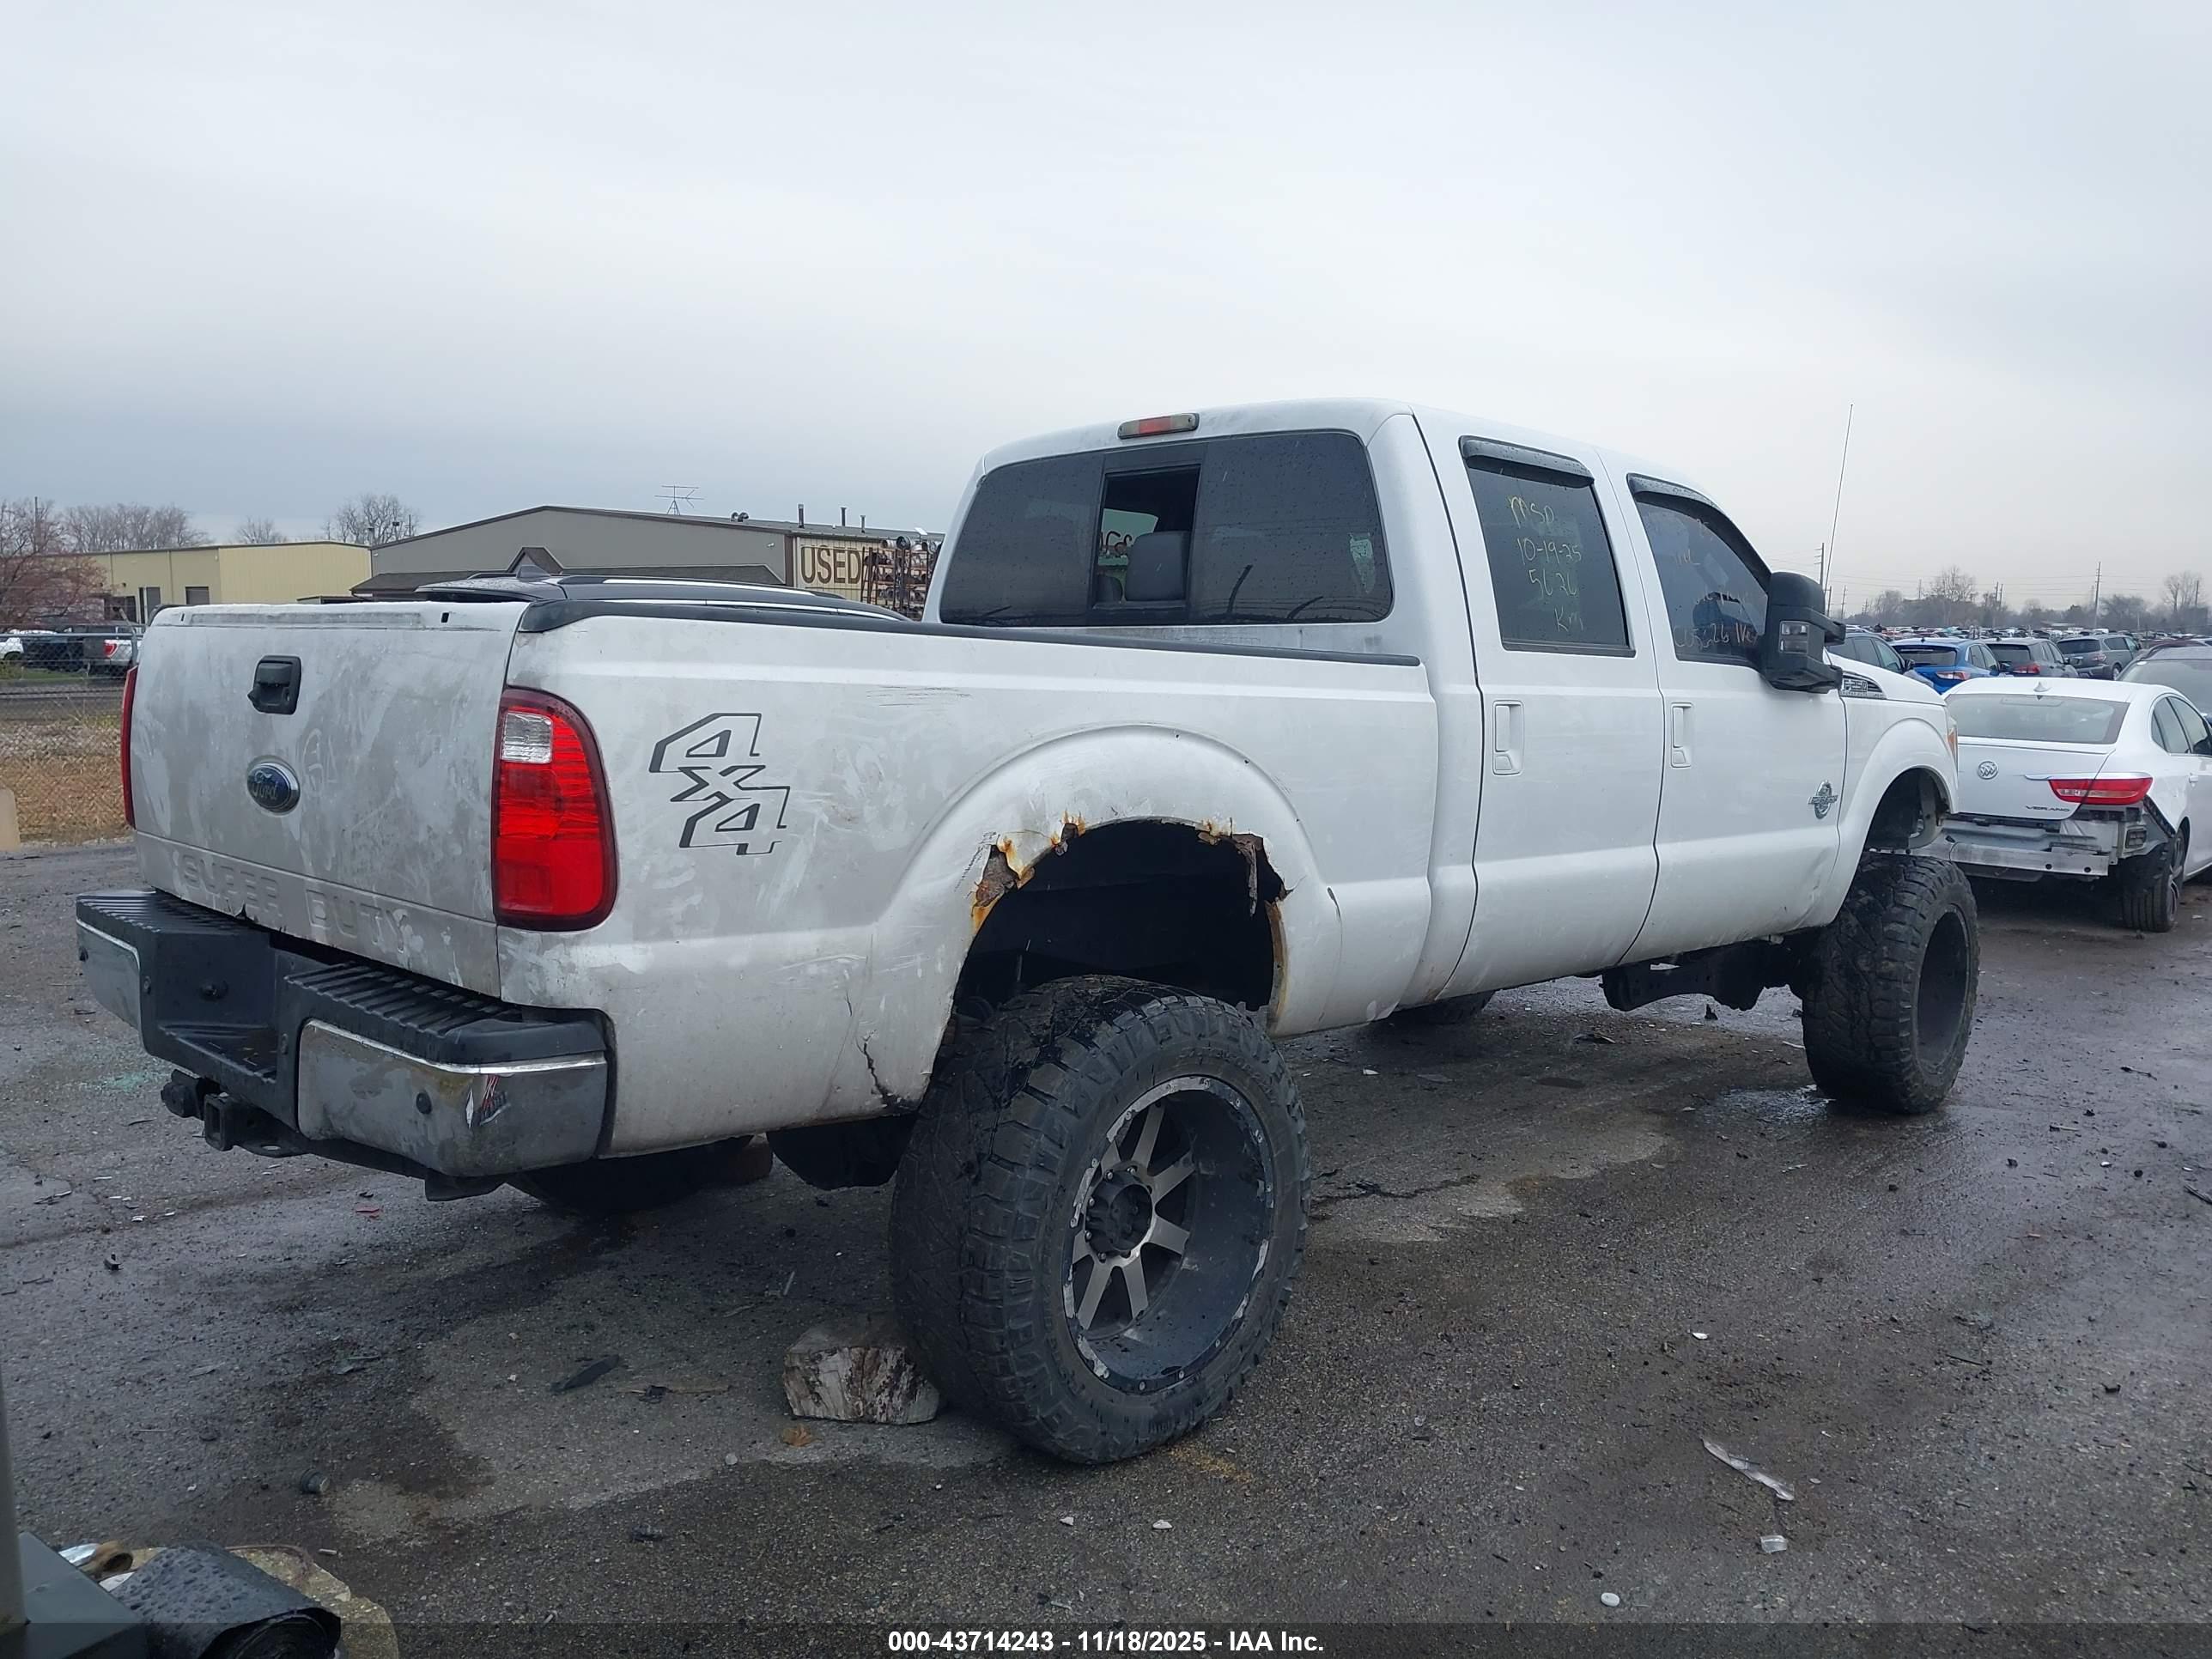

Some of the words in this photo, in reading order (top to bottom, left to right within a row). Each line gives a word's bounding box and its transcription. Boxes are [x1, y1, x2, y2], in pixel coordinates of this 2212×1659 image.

[800, 544, 862, 584] USED
[182, 854, 283, 918] SUPER
[305, 889, 408, 953] DUTY
